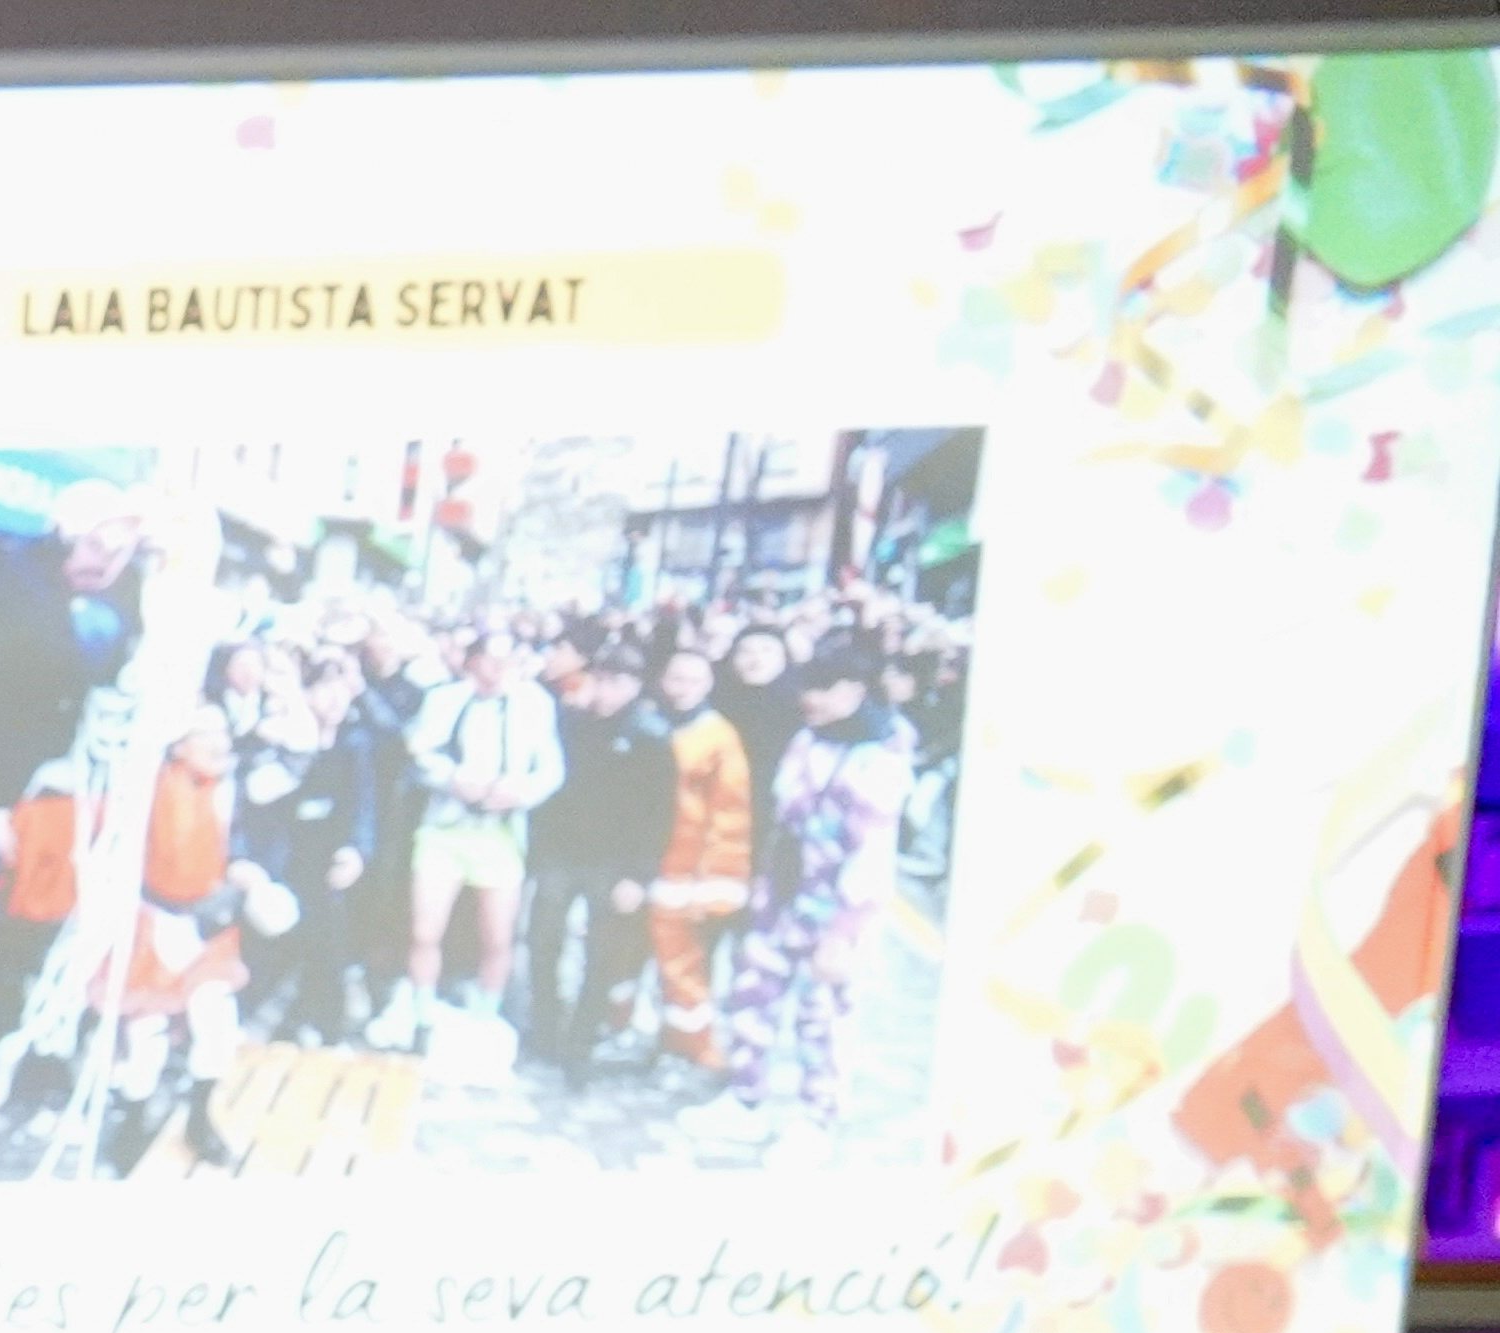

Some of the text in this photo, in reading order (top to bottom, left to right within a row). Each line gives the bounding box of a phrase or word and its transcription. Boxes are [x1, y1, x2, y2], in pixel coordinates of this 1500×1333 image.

[22, 276, 586, 336] LAIA BAUTISTA SERVAT
[298, 1231, 382, 1323] la
[428, 1273, 595, 1323] seva
[634, 1211, 1000, 1317] atenció!
